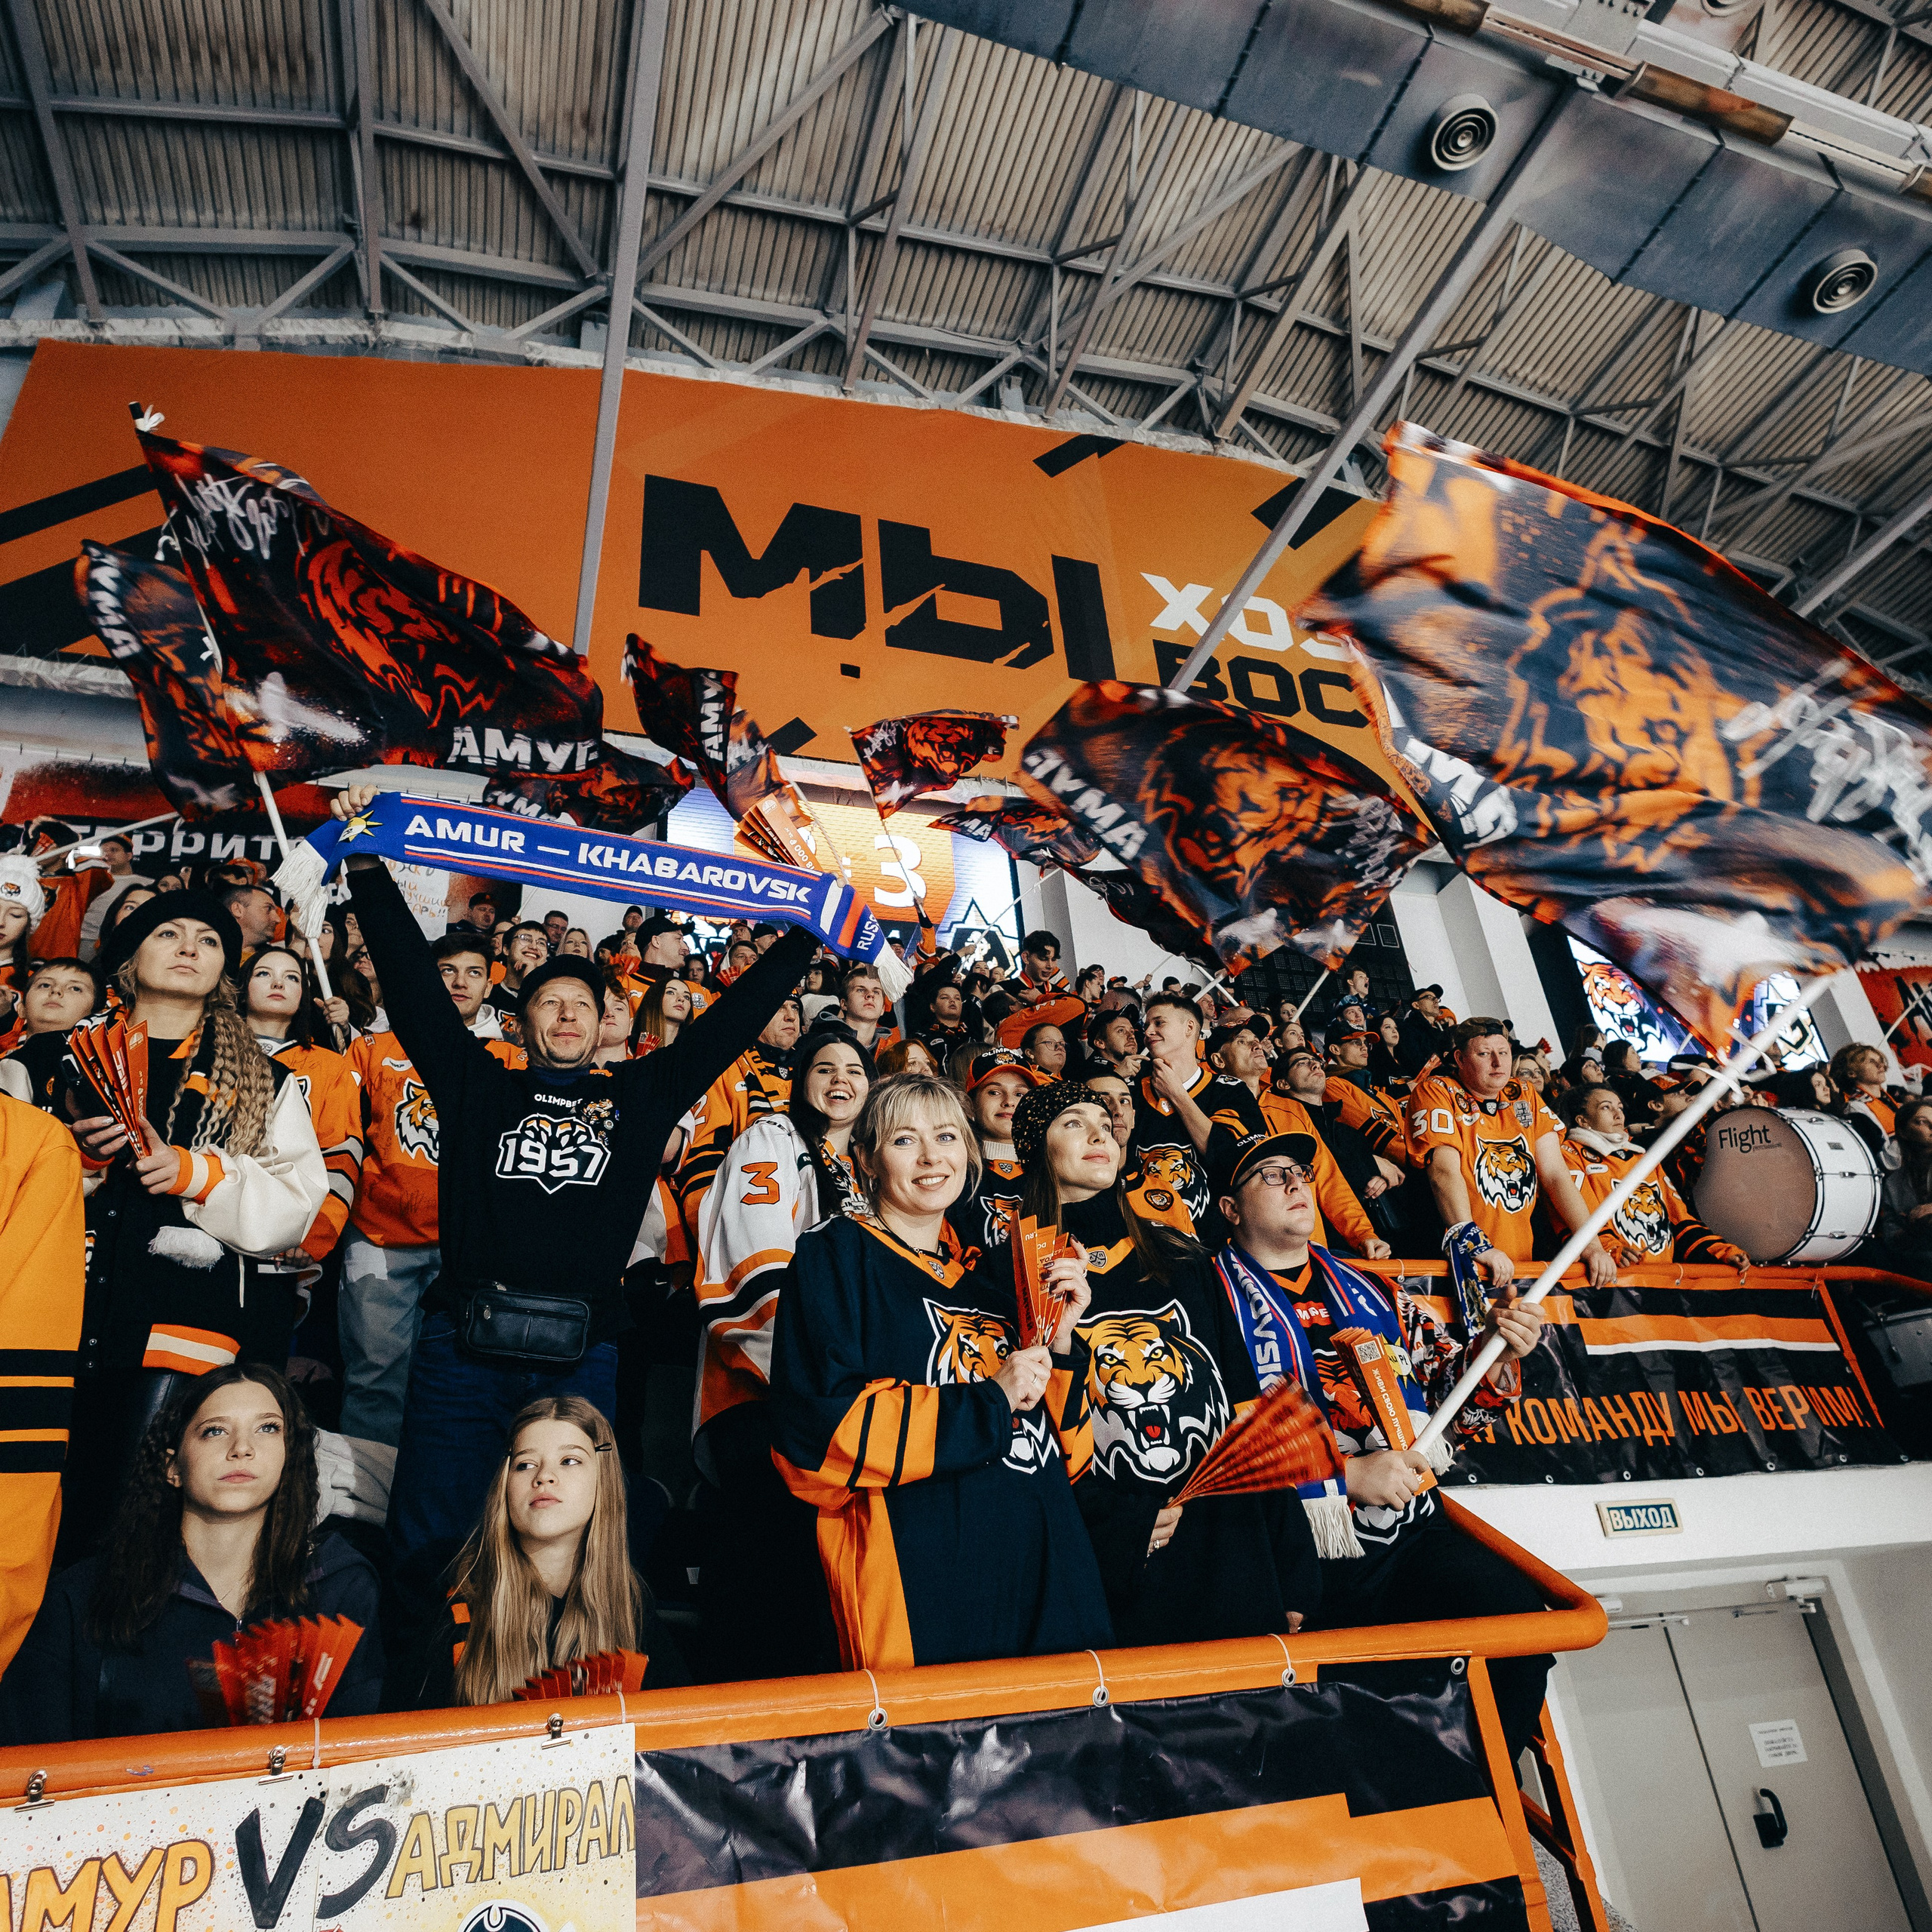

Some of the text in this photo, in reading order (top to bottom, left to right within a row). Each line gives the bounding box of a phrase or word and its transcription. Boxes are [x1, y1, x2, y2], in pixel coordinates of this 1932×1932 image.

[638, 473, 1118, 681] МЫ
[404, 814, 526, 854] AMUR
[577, 842, 813, 904] KHABAROVSK
[873, 834, 927, 909] 3
[534, 1093, 583, 1108] OLIMPBET
[1411, 1107, 1456, 1139] 30
[503, 1137, 604, 1179] 1957
[1718, 1124, 1772, 1154] Flight
[740, 1161, 780, 1206] 3
[1371, 1367, 1410, 1451] ЖИВИ СВОЮ ЛУЧШУЮ
[1507, 1391, 1675, 1446] КОМАНДУ
[1677, 1390, 1748, 1435] МЫ
[1743, 1385, 1871, 1431] ВЕРИМ!
[1608, 1506, 1676, 1531] ВЫХОД
[0, 1774, 636, 1932] МУР VS АДМИРАЛ
